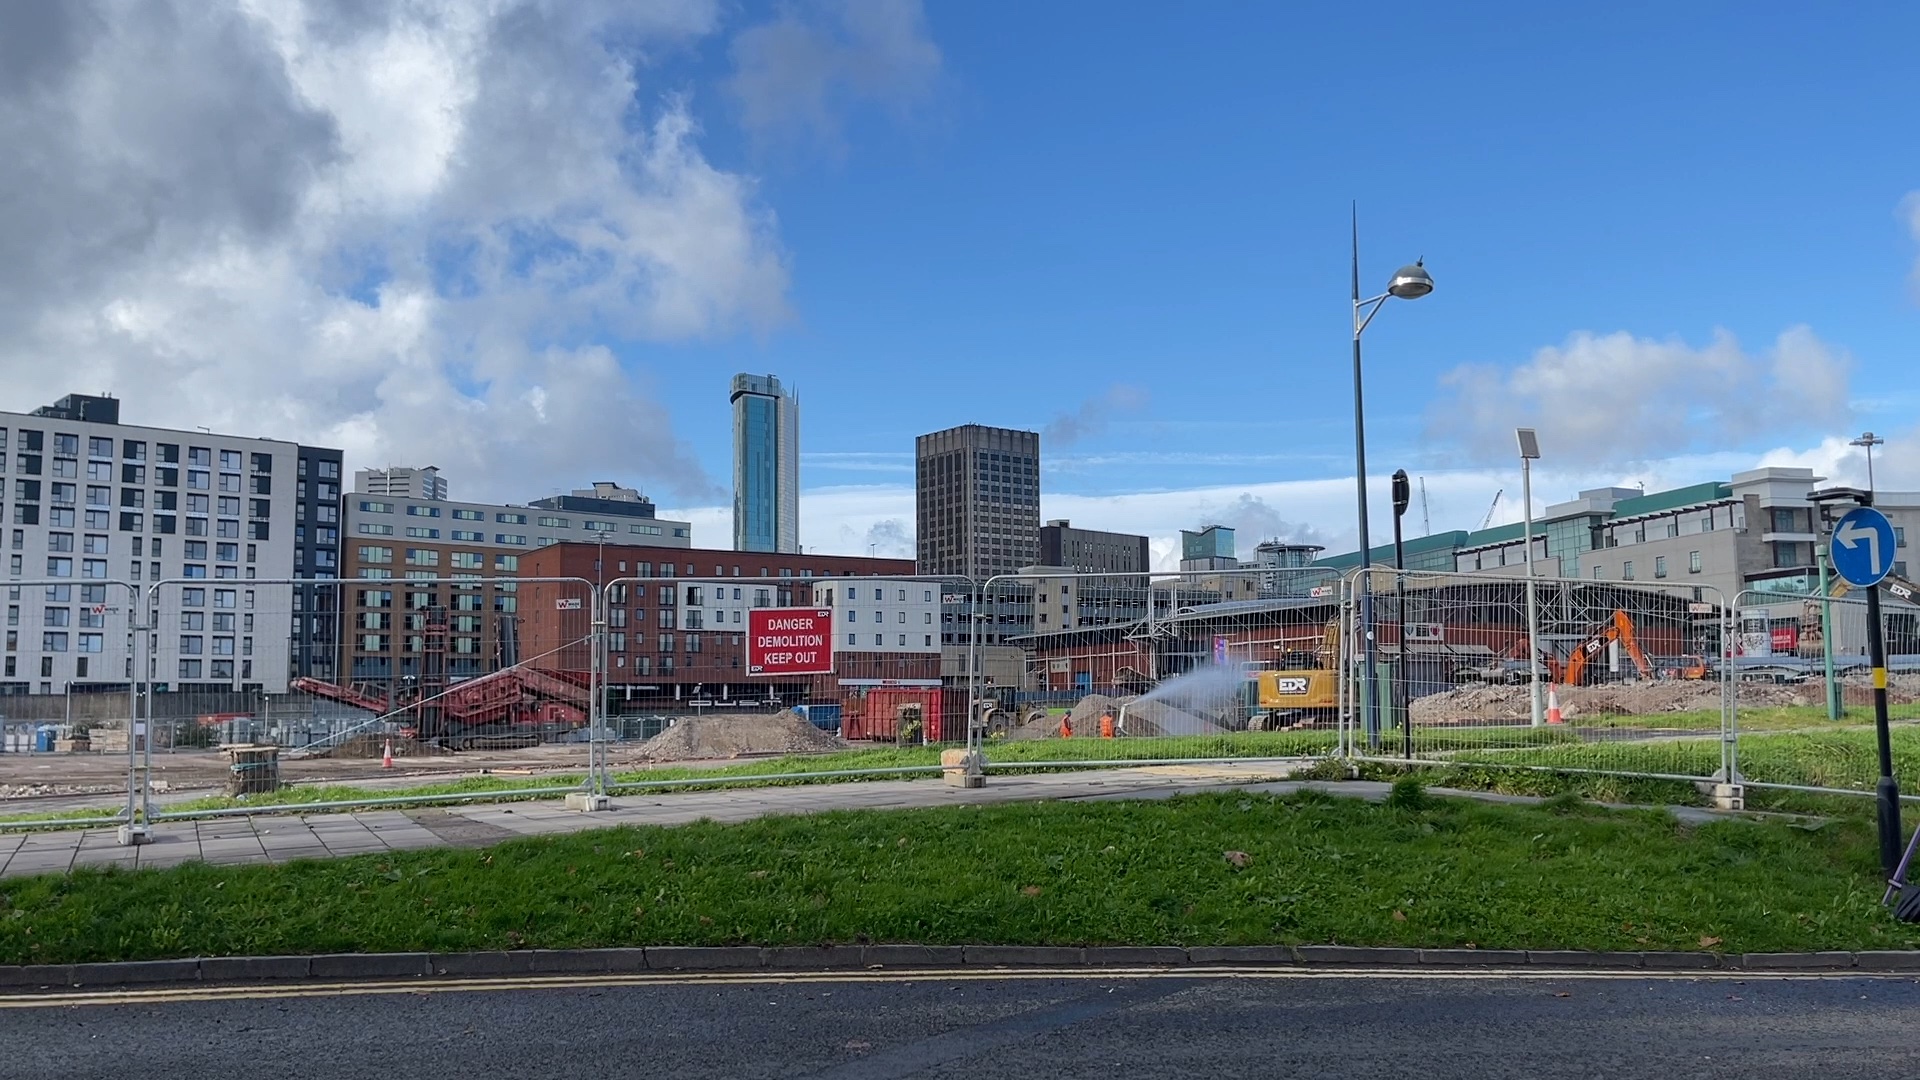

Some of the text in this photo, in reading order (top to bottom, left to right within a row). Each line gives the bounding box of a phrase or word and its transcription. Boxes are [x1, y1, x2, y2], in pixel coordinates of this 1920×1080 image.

[1890, 583, 1911, 599] EDR
[768, 618, 814, 631] DANGER
[758, 634, 823, 648] DEMOLITION
[764, 651, 817, 665] KEEP OUT
[1279, 678, 1306, 691] EDR
